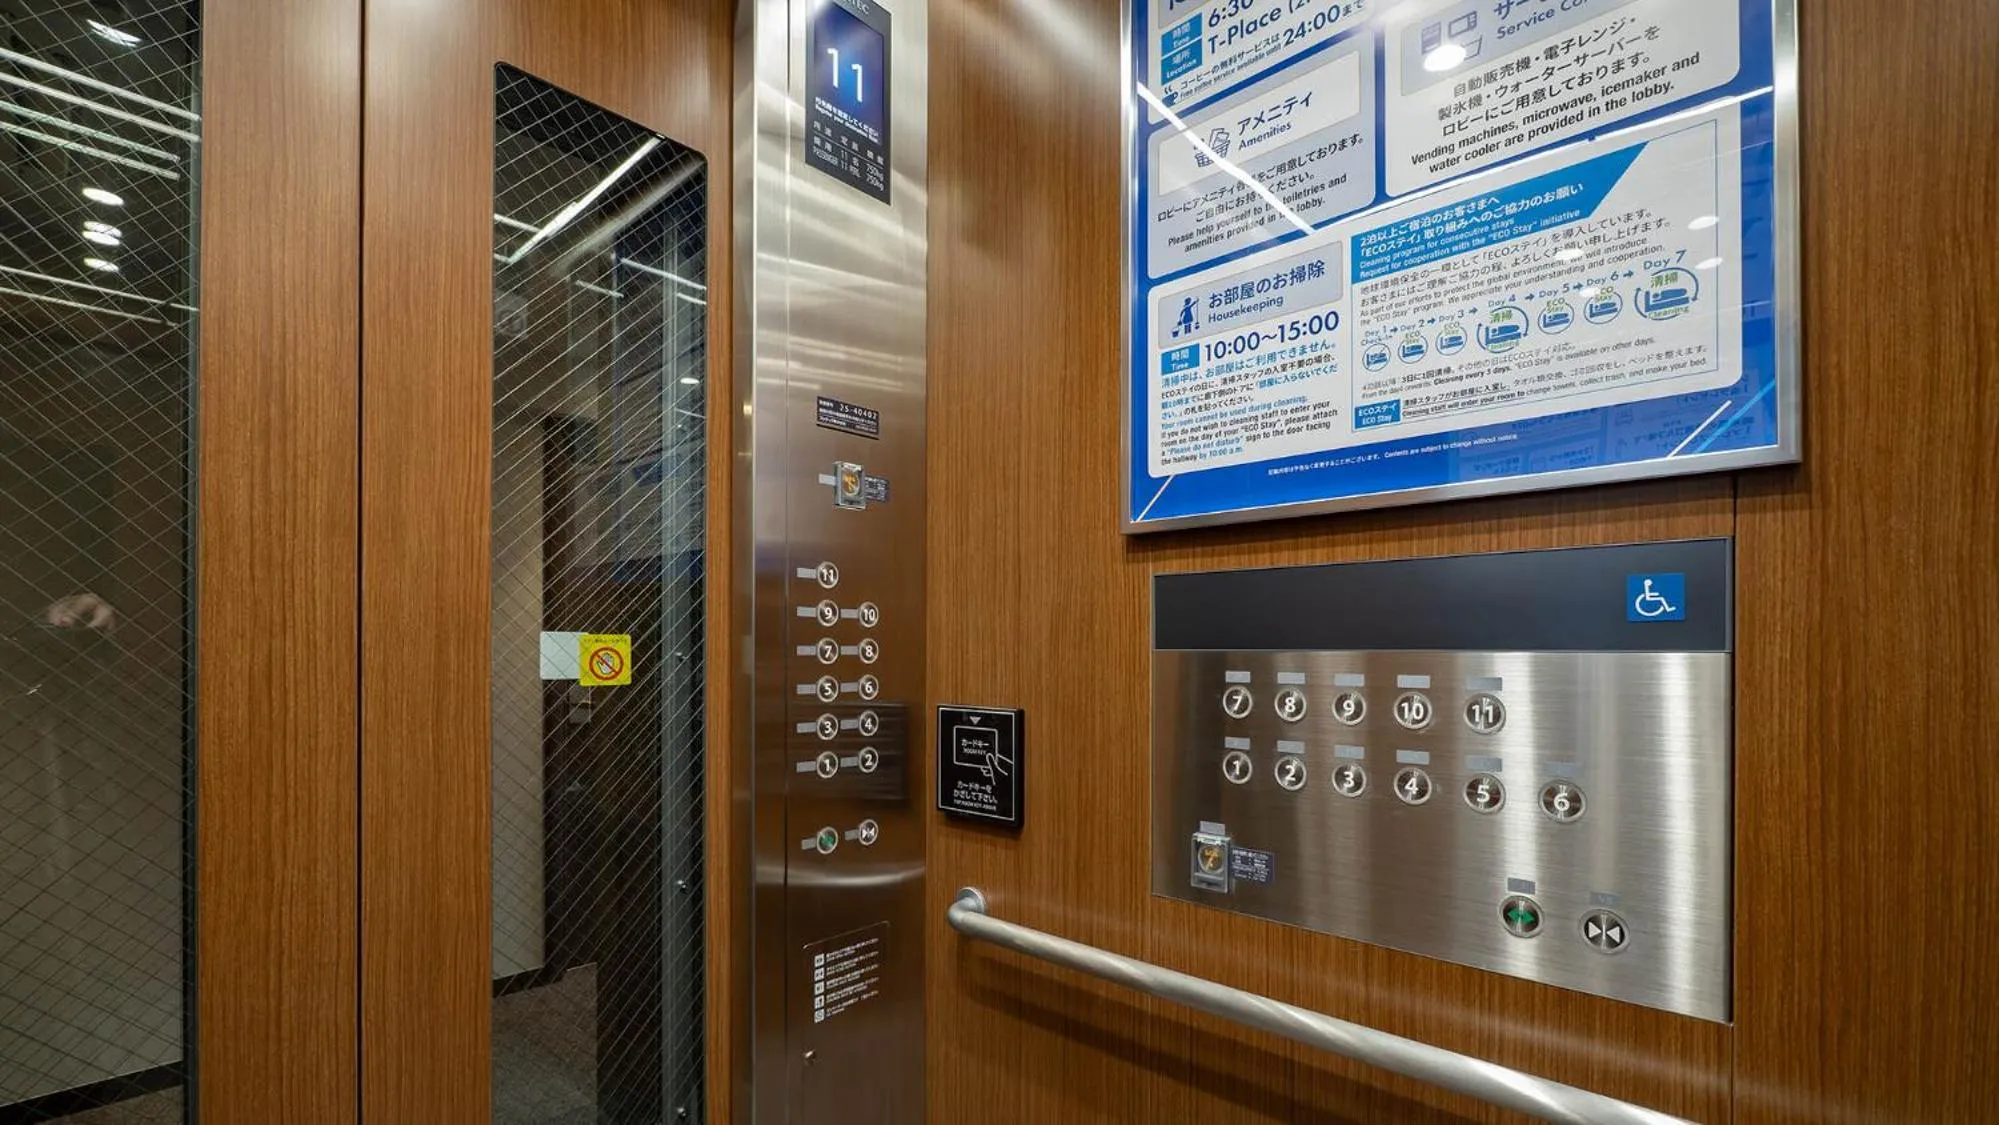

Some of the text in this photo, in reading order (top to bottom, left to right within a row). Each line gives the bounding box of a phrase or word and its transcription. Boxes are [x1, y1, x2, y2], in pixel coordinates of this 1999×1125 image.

[1208, 7, 1282, 54] T-Place
[1496, 8, 1555, 39] Service
[827, 47, 863, 103] 11
[1437, 25, 1661, 122] 製氷機・ウォーターサーバーを
[1442, 54, 1651, 137] ロビーにご用意しております。
[1236, 88, 1312, 137] アメニティ
[1410, 50, 1699, 168] Vending machines, microwave, icemaker and
[1428, 75, 1674, 174] water cooler are provided in the lobby.
[1238, 119, 1291, 151] Amenities
[1167, 228, 1194, 248] Please
[1196, 219, 1214, 238] help
[1216, 206, 1251, 232] yourself
[1253, 202, 1262, 217] to
[1281, 179, 1325, 206] toiletries
[1328, 172, 1346, 188] and
[1183, 228, 1224, 253] amenities
[1266, 210, 1276, 223] in
[1296, 193, 1326, 214] lobby.
[1359, 216, 1514, 270] Cleaning program for consecutive stays
[1390, 259, 1402, 270] for
[1403, 245, 1450, 267] cooperation
[1452, 239, 1469, 253] with
[1539, 206, 1580, 227] initiative
[1486, 271, 1510, 285] global
[1602, 236, 1647, 255] introduce
[1587, 257, 1604, 269] and
[1642, 248, 1687, 271] Day 7
[1208, 258, 1325, 309] お部屋のお掃除
[1585, 270, 1619, 288] Day 6
[1649, 270, 1679, 289] 清掃
[1508, 293, 1516, 303] 4
[1537, 282, 1570, 300] Day 5
[1207, 291, 1284, 325] Housekeeping
[1546, 296, 1565, 308] ECO
[1647, 303, 1689, 320] Cleaning
[1417, 318, 1425, 328] 2
[1456, 308, 1464, 319] 3
[1170, 359, 1188, 372] Time
[1628, 368, 1643, 377] and
[1433, 373, 1464, 386] Cleaning
[1464, 369, 1484, 380] every
[1280, 407, 1288, 416] to
[1290, 403, 1310, 414] enter
[1312, 399, 1330, 411] your
[1284, 413, 1310, 426] please
[1312, 407, 1338, 420] attach
[1358, 402, 1396, 417] ECOステイ
[1262, 430, 1270, 439] to
[1272, 427, 1284, 437] the
[822, 568, 834, 581] 11
[824, 608, 875, 621] 9 10
[824, 645, 873, 658] 7 8
[824, 682, 873, 696] 5 6
[1233, 695, 1494, 723] 7 8 9 10 11
[825, 718, 872, 733] 3 4
[825, 754, 872, 771] 1 2
[1233, 760, 1568, 811] 1 2 3 4 5 6
